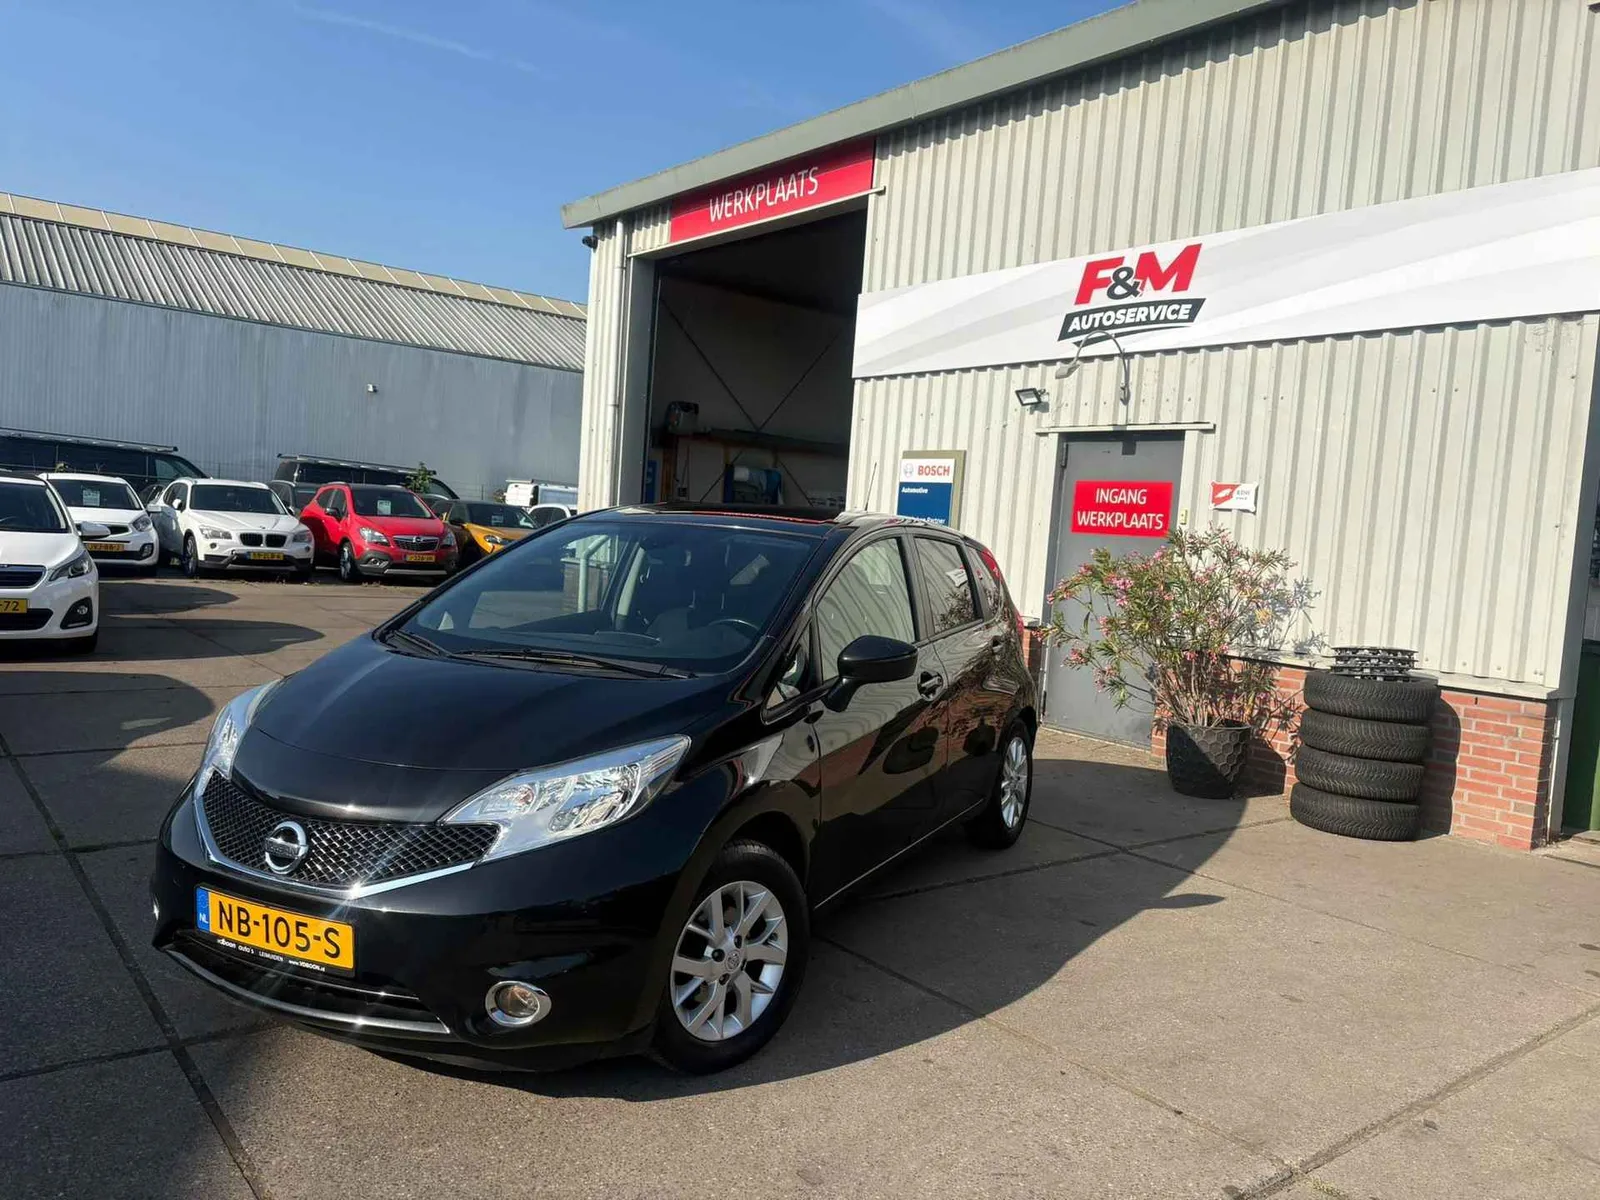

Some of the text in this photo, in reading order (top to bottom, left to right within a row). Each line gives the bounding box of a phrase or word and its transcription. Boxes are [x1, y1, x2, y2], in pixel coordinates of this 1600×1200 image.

[709, 167, 818, 222] WERKPLAATS
[1074, 243, 1202, 305] F&M
[1068, 304, 1192, 333] AUTOSERVICE
[917, 465, 950, 476] BOSCH
[1095, 488, 1147, 504] INGANG
[1077, 511, 1164, 530] WERKPLAATS
[199, 913, 209, 923] NL
[218, 901, 341, 958] NB-105-S
